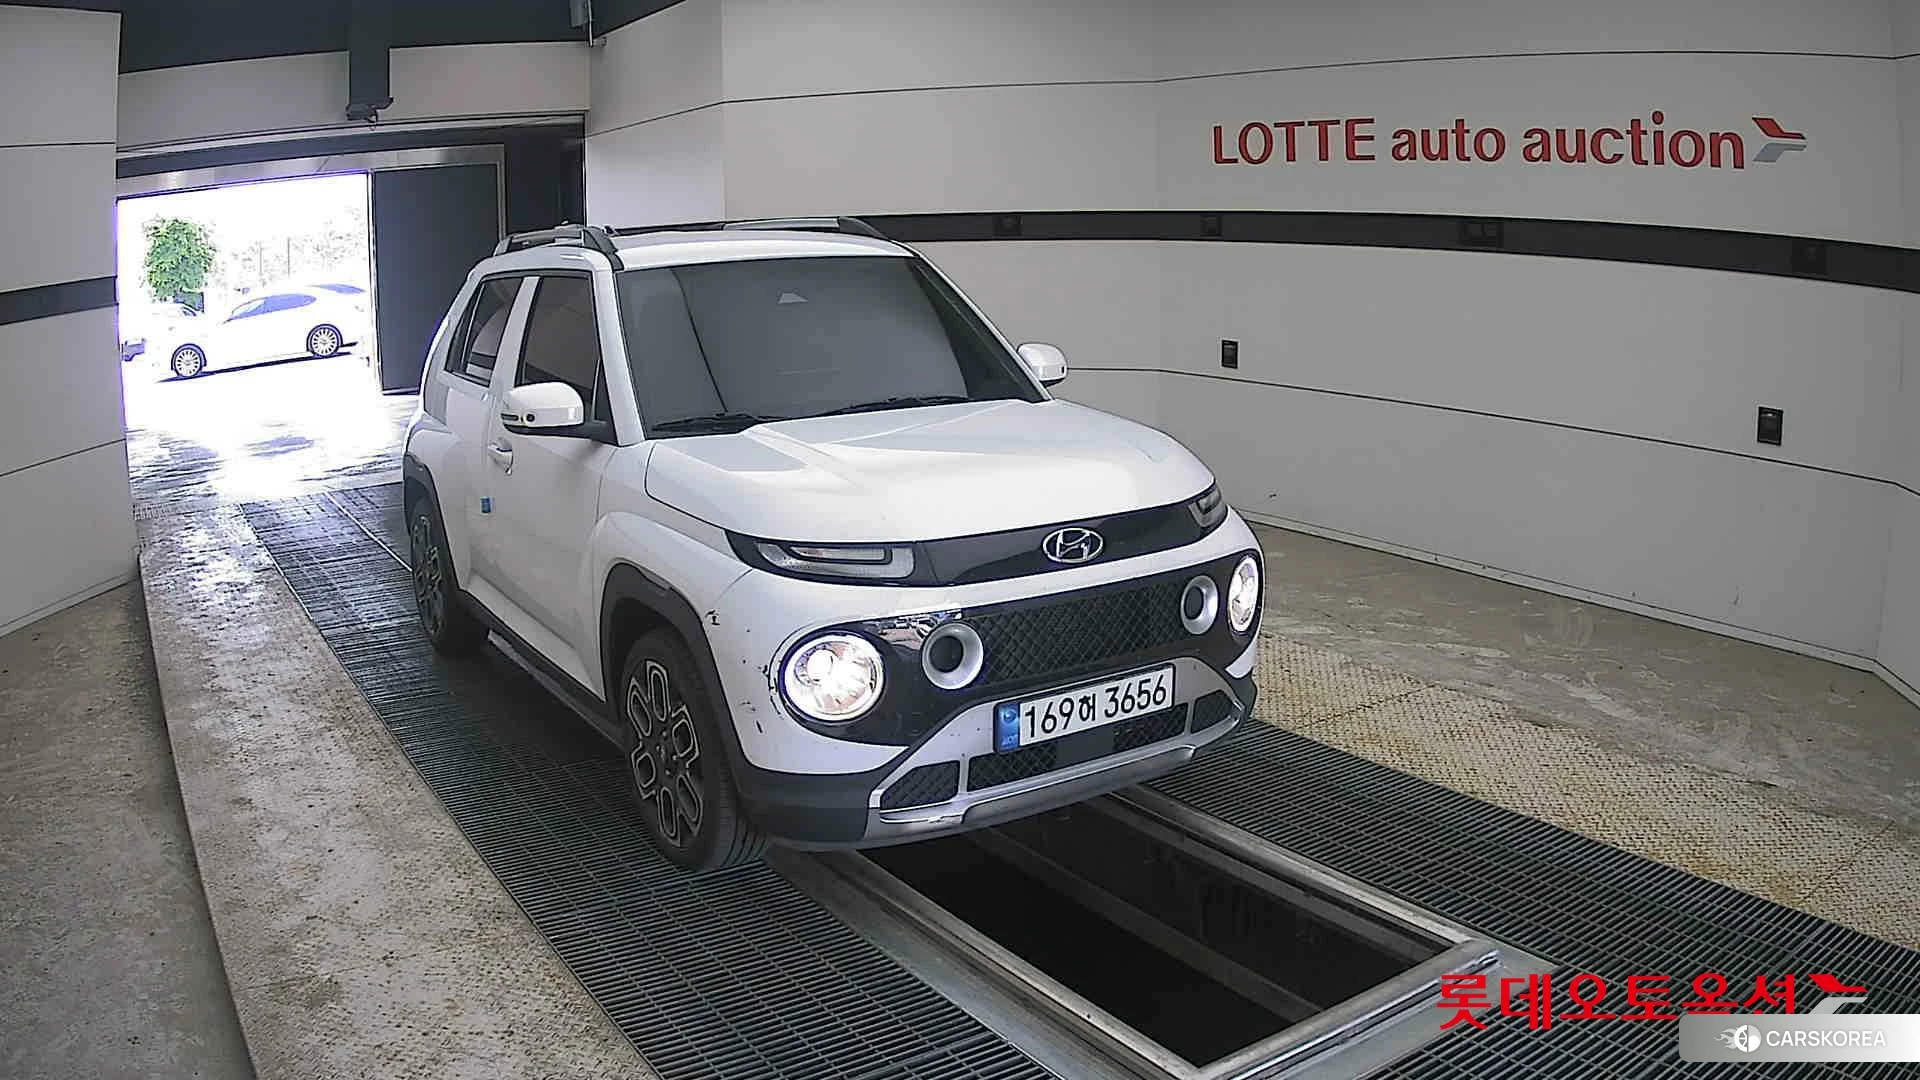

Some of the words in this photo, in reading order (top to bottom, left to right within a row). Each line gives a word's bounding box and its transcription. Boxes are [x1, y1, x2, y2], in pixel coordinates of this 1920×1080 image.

[1212, 118, 1375, 164] LOTTE
[1392, 118, 1506, 162] auto
[1522, 111, 1746, 170] auction
[1024, 692, 1097, 738] 169허
[1103, 674, 1167, 718] 3656
